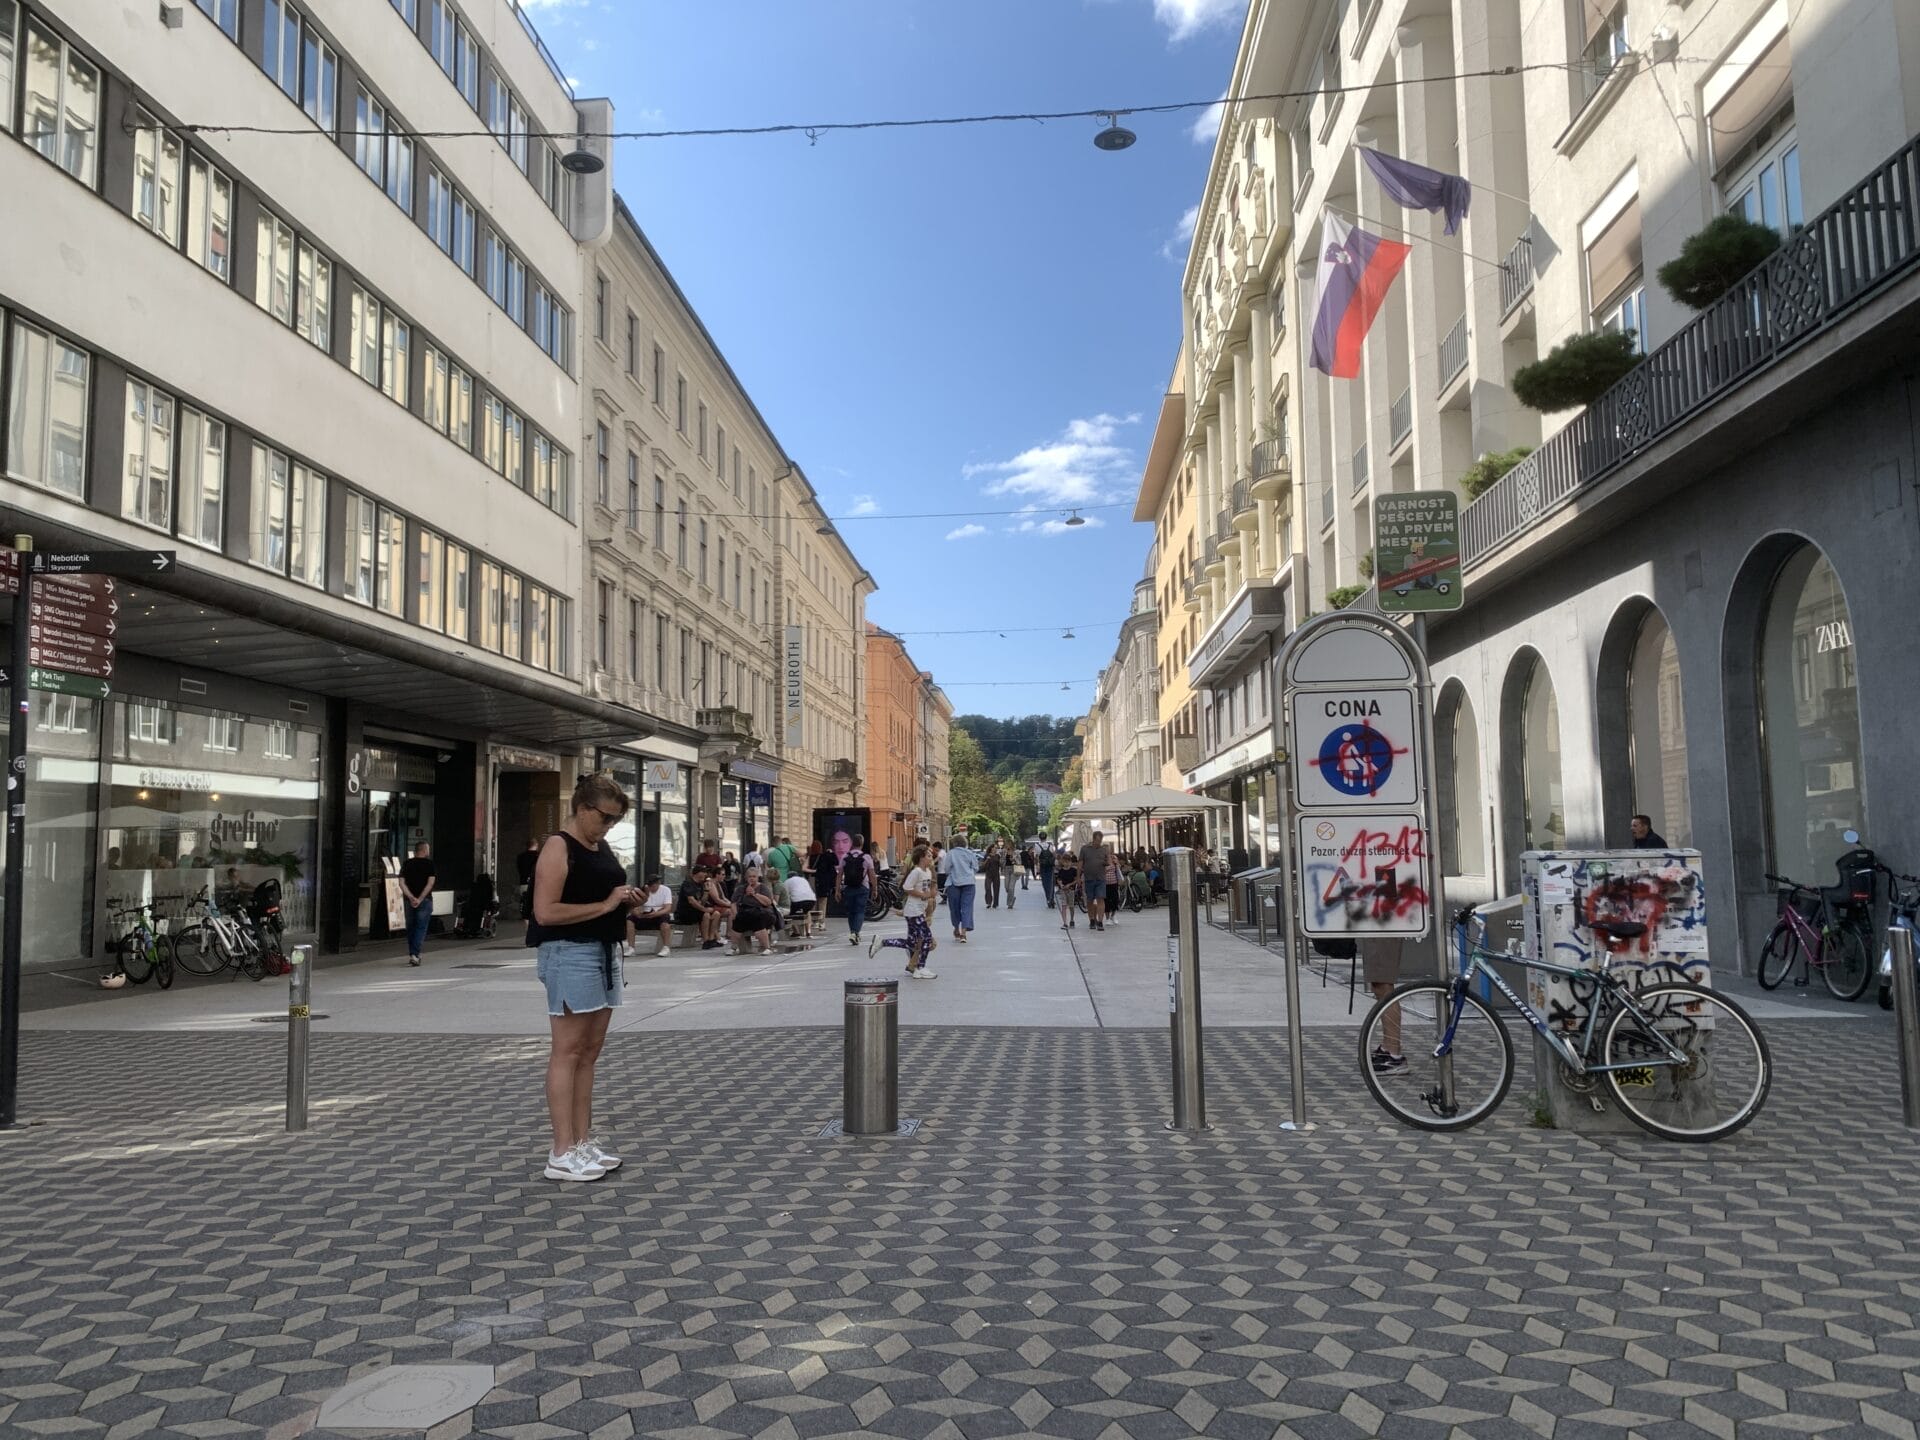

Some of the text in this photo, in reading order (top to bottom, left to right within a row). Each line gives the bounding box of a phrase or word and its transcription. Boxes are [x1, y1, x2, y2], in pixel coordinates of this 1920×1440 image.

[1379, 499, 1446, 511] VARNOST
[1437, 510, 1454, 520] JE
[1380, 522, 1454, 535] NA PRVEM
[1380, 536, 1428, 548] MESTU
[50, 554, 90, 562] Nebotičnik
[1815, 620, 1853, 653] ZARA
[788, 642, 800, 708] NEUROTH
[1324, 700, 1382, 718] CONA
[1496, 979, 1540, 1025] WHEELER
